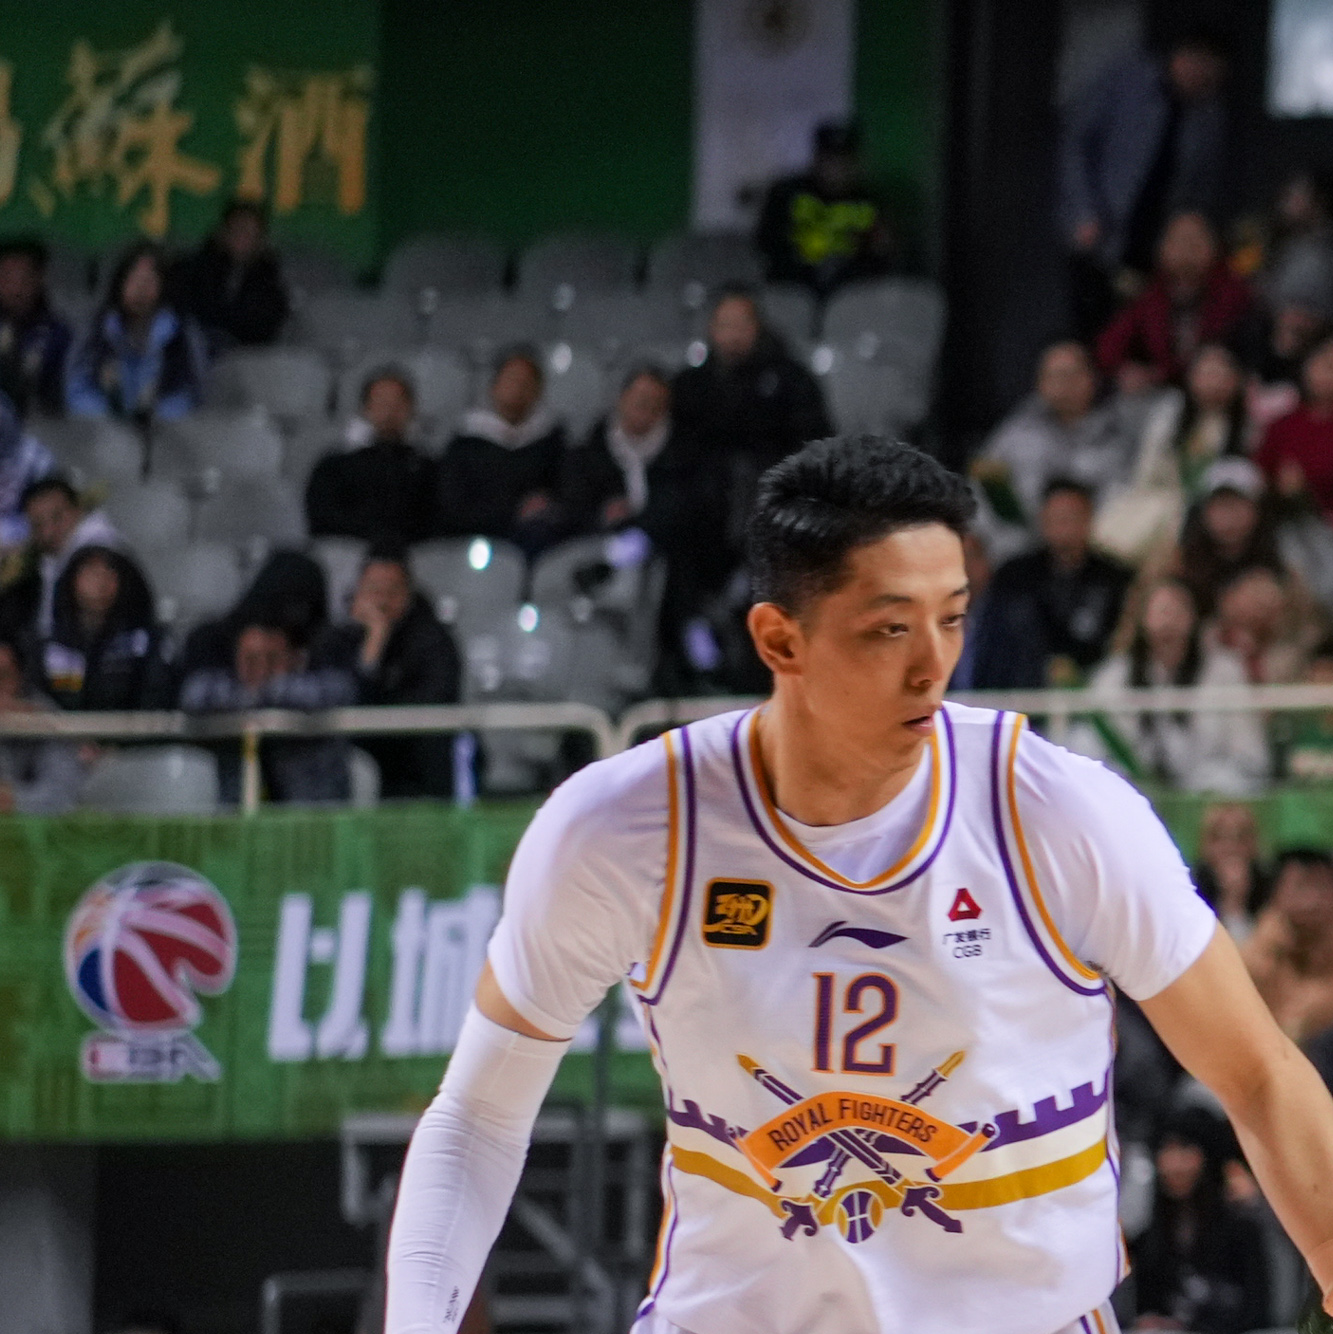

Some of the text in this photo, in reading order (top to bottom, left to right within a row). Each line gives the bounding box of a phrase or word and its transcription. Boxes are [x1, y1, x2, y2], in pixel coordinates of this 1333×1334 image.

[0, 21, 374, 236] 蘇酒
[953, 944, 983, 959] CGB
[811, 972, 899, 1076] 12
[768, 1098, 938, 1153] ROYAL FIGHTERS
